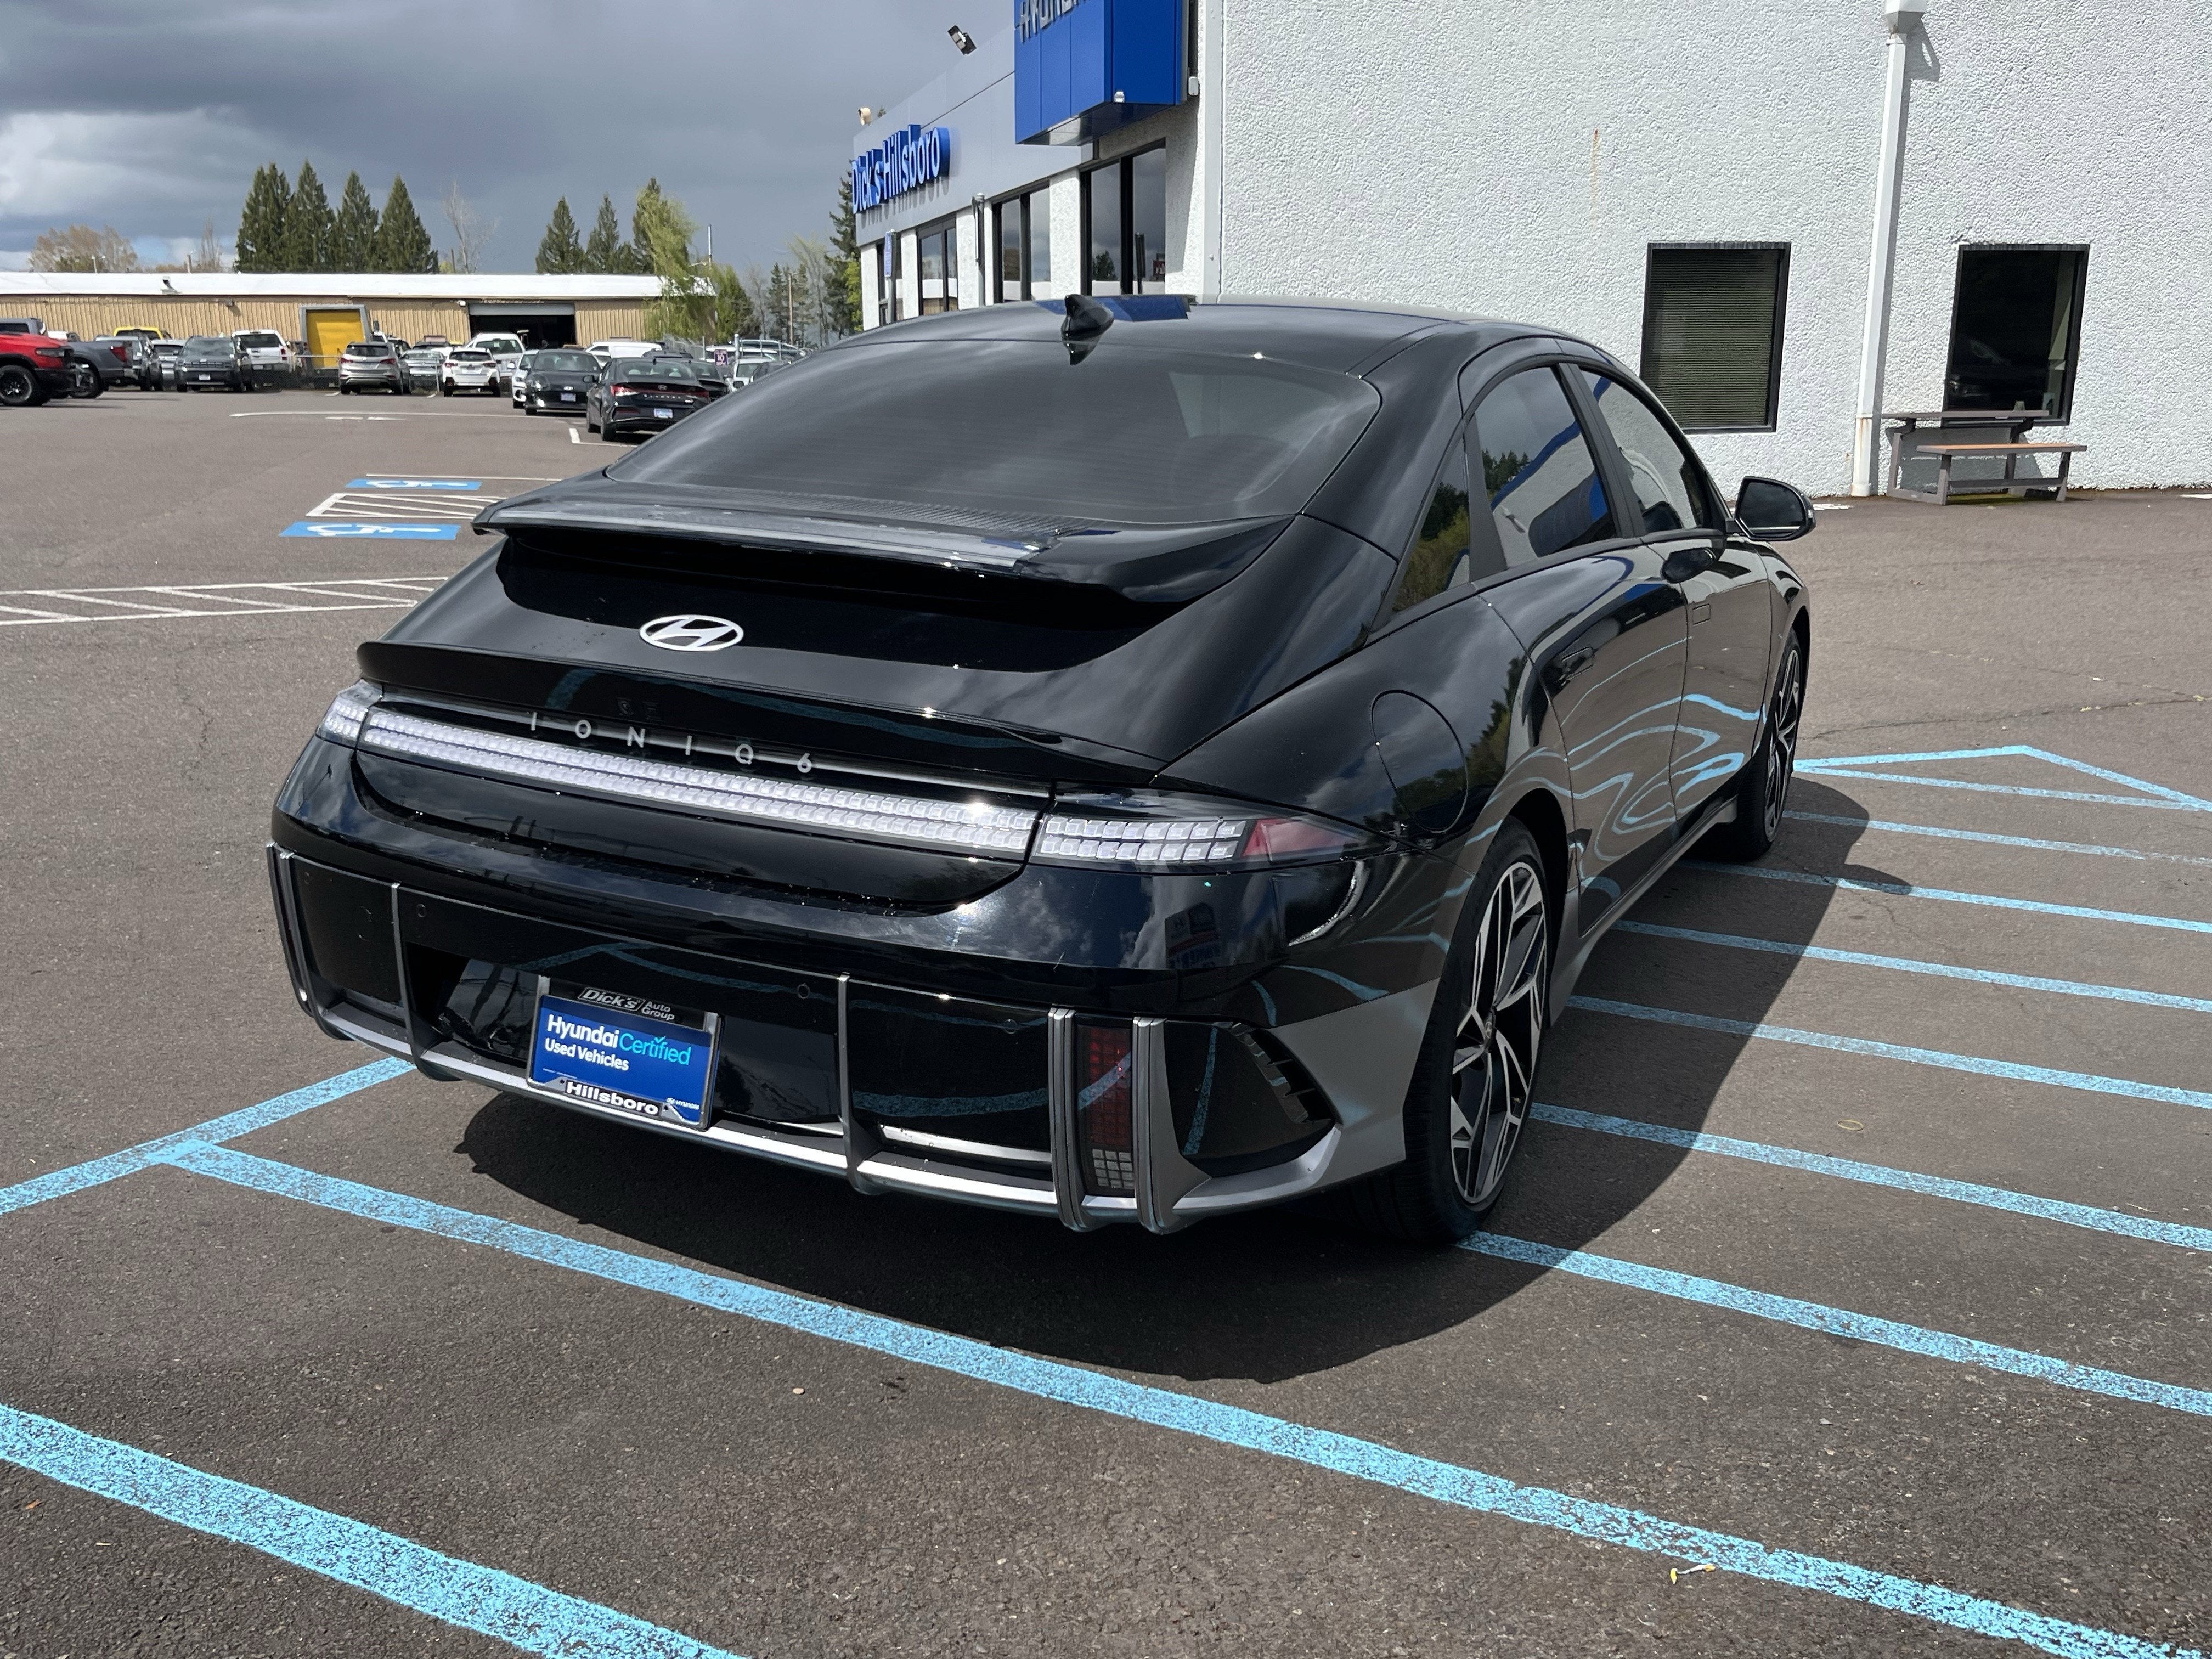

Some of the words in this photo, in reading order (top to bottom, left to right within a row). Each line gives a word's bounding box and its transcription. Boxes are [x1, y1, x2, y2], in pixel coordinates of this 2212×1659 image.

[851, 149, 881, 215] Dick's
[883, 125, 940, 200] Hillsboro
[530, 712, 754, 765] IONIQ
[797, 753, 812, 773] 6
[583, 989, 638, 1009] Dick's
[641, 1007, 675, 1021] Group
[644, 1001, 671, 1012] Auto
[544, 1037, 577, 1058] Used
[577, 1047, 629, 1071] Vehicles
[546, 1014, 620, 1048] Hyundai
[619, 1032, 692, 1065] Certified
[566, 1081, 659, 1116] Hillsboro
